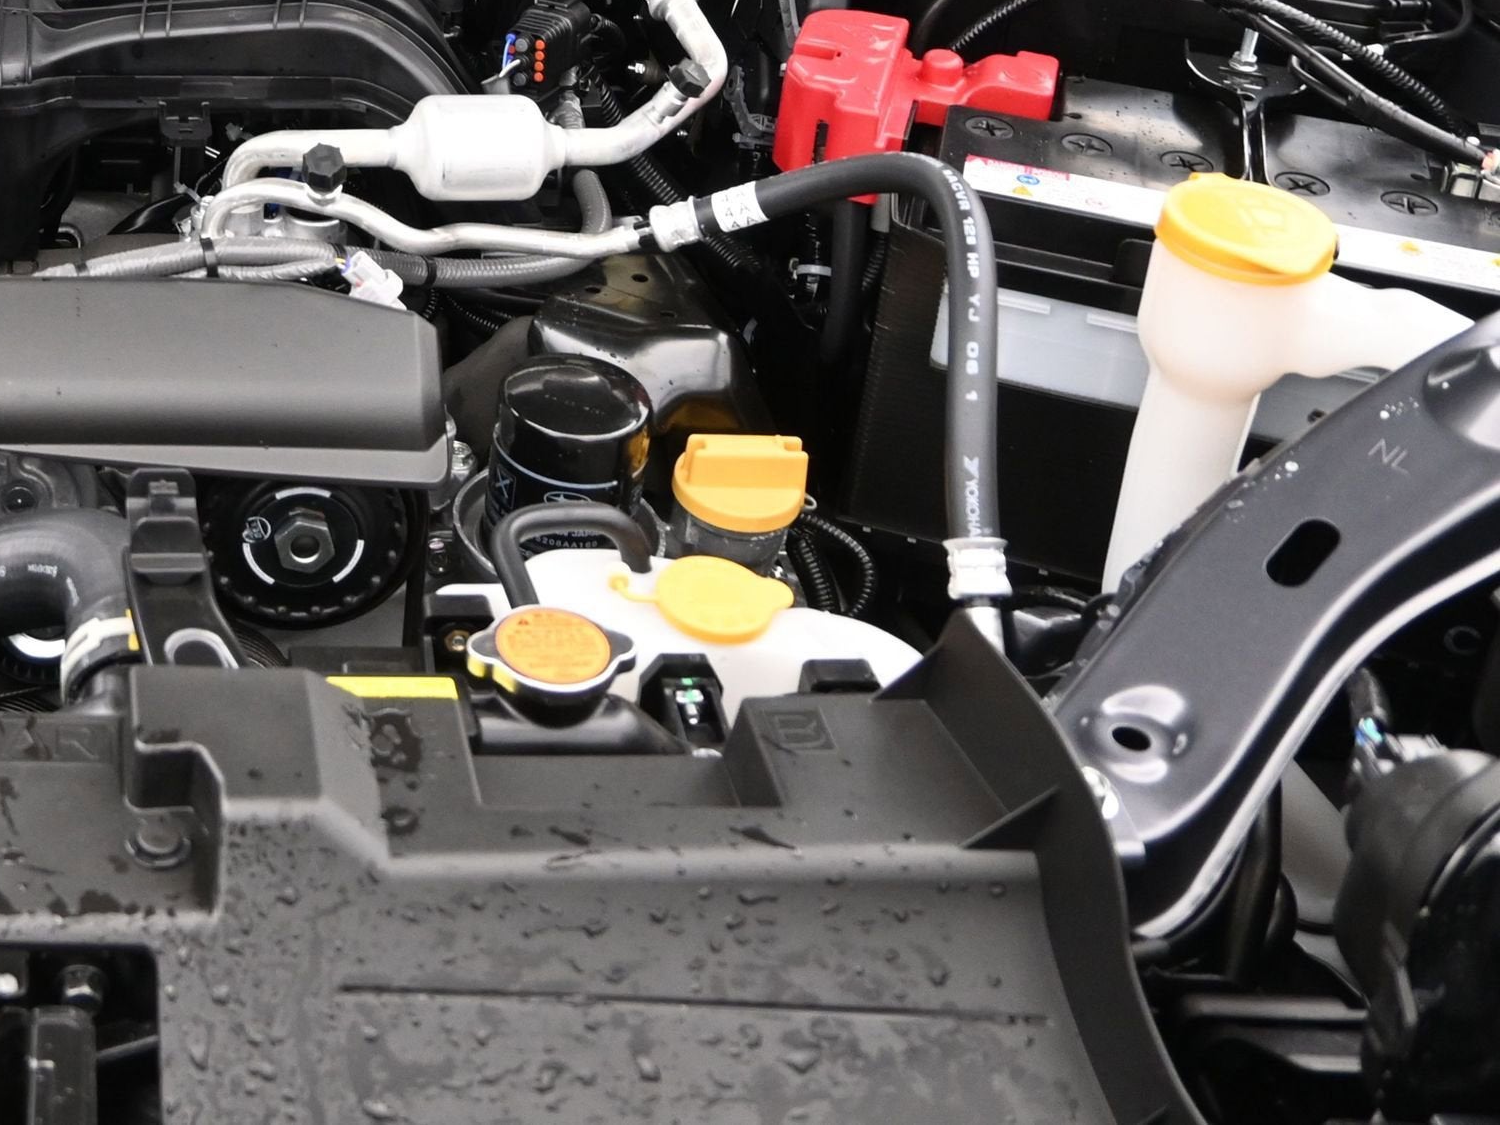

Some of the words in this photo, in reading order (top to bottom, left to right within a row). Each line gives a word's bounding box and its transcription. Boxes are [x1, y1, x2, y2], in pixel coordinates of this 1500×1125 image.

[967, 252, 980, 279] HP
[968, 293, 981, 322] YJ
[1367, 438, 1410, 477] NL
